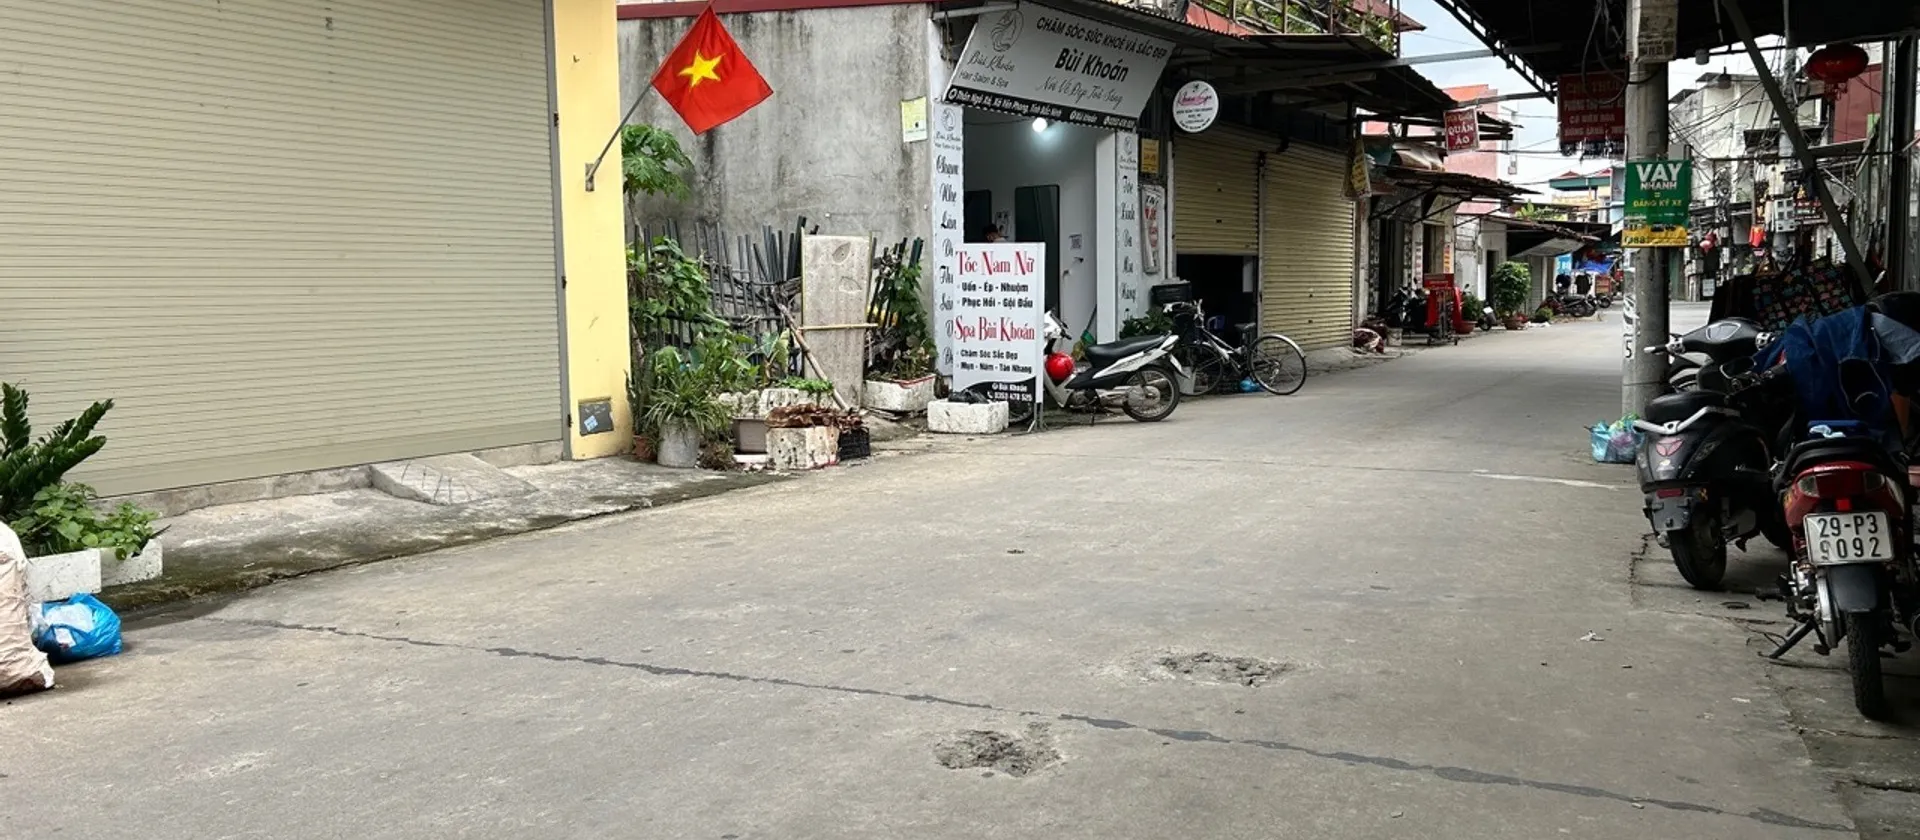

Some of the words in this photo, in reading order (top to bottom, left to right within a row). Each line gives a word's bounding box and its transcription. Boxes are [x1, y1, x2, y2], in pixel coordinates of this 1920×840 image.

[1037, 17, 1064, 34] CHĂM
[1065, 23, 1085, 39] SÓC
[1085, 28, 1103, 44] SỨC
[1125, 38, 1137, 52] VÀ
[1135, 40, 1153, 57] SẮC
[1152, 47, 1168, 62] ĐẸP
[1055, 47, 1084, 72] Bùi
[1082, 53, 1129, 82] Khoán
[1455, 134, 1470, 145] ÁO
[1635, 163, 1682, 182] VAY
[1640, 182, 1677, 191] NHANH
[1633, 198, 1657, 207] ĐĂNG
[1660, 198, 1669, 207] KÝ
[955, 251, 978, 275] Tóc
[981, 251, 1011, 275] Nam
[1014, 251, 1035, 275] Nữ
[962, 281, 976, 292] Uốn
[984, 281, 994, 293] Ép
[1001, 282, 1029, 294] Nhuộm
[962, 297, 981, 308] Phục
[983, 297, 995, 307] Hồi
[1003, 297, 1015, 310] Gội
[1017, 297, 1033, 308] Đầu
[954, 315, 975, 343] Spa
[979, 316, 997, 341] Bùi
[1000, 316, 1035, 342] Khoán
[961, 349, 978, 358] Chăm
[1005, 351, 1018, 360] Đẹp
[1625, 340, 1632, 358] 5
[1012, 364, 1032, 374] Nhang
[1817, 513, 1878, 538] 29-P3
[1820, 537, 1881, 560] 9092
